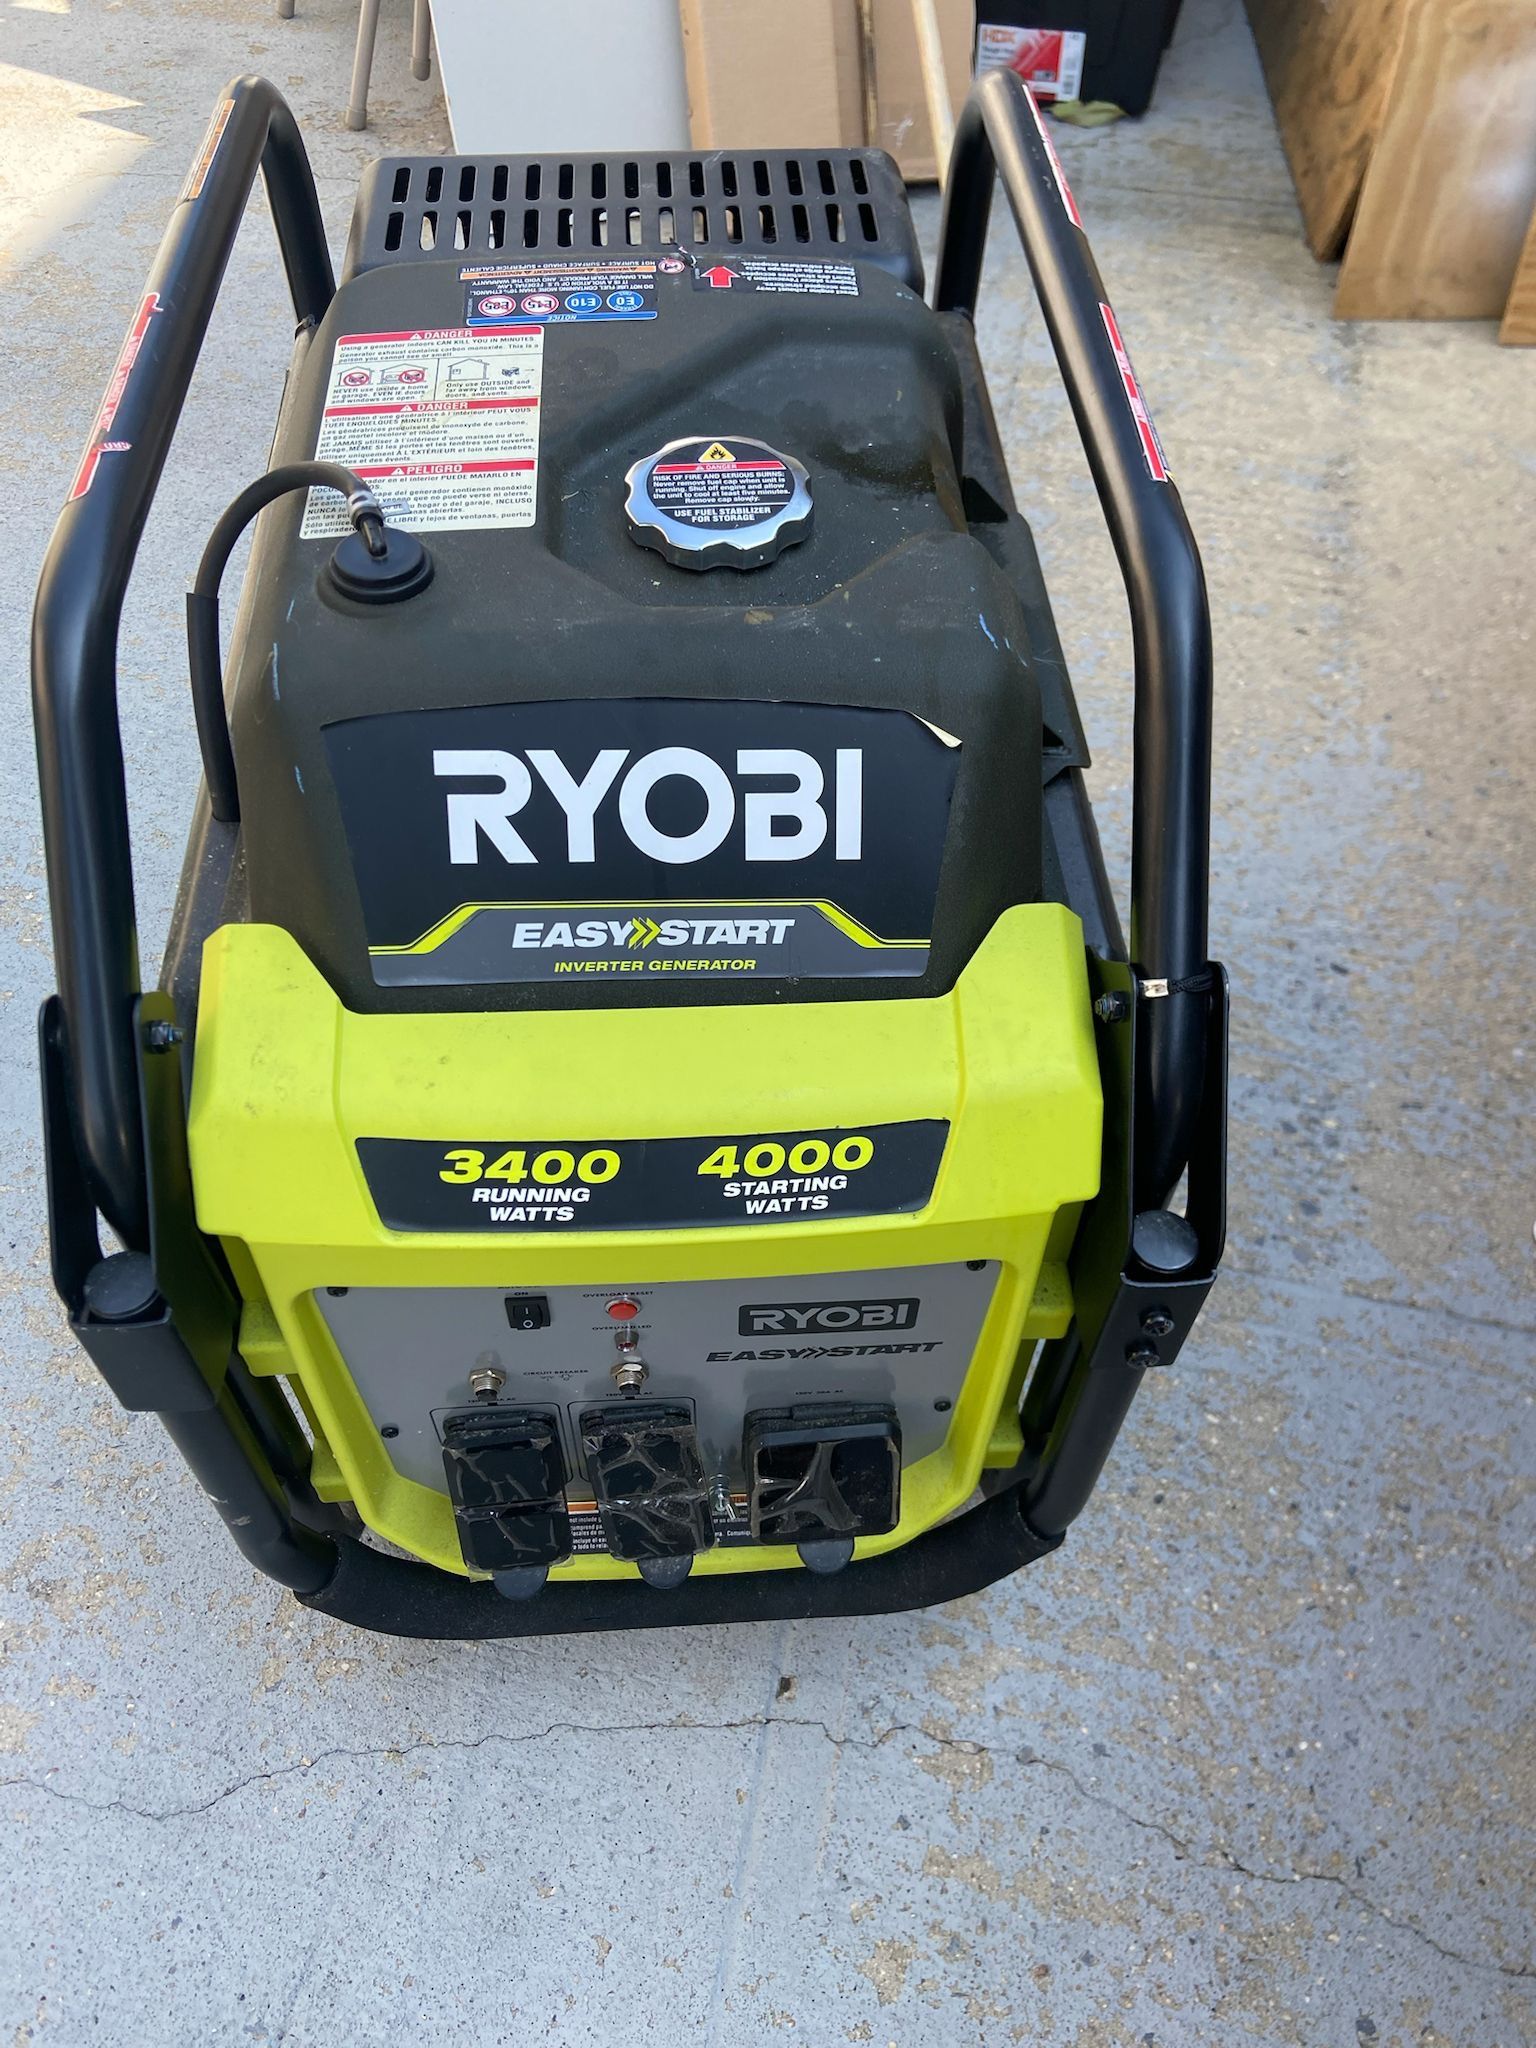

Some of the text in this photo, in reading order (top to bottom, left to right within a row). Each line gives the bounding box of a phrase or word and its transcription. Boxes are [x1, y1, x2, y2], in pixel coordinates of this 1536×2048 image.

[570, 297, 595, 306] E10
[616, 296, 634, 305] E0
[423, 330, 473, 339] DANGER
[416, 401, 468, 412] DANGER
[406, 463, 463, 475] PELIGRO
[469, 471, 508, 479] MATARLO
[693, 508, 717, 516] FUEL
[719, 506, 771, 515] STABILIZER
[712, 514, 754, 522] STORAGE
[433, 746, 863, 865] RYOBI
[512, 918, 796, 949] EASY START
[554, 958, 757, 974] INVERTER GENERATOR
[697, 1136, 875, 1179] 4000
[438, 1149, 622, 1184] 3400
[722, 1174, 849, 1198] STARTING
[471, 1187, 591, 1203] RUNNING
[744, 1194, 829, 1216] WATTS
[489, 1206, 575, 1223] WATTS
[750, 1303, 909, 1331] RYOBI
[705, 1341, 944, 1362] EASY START
